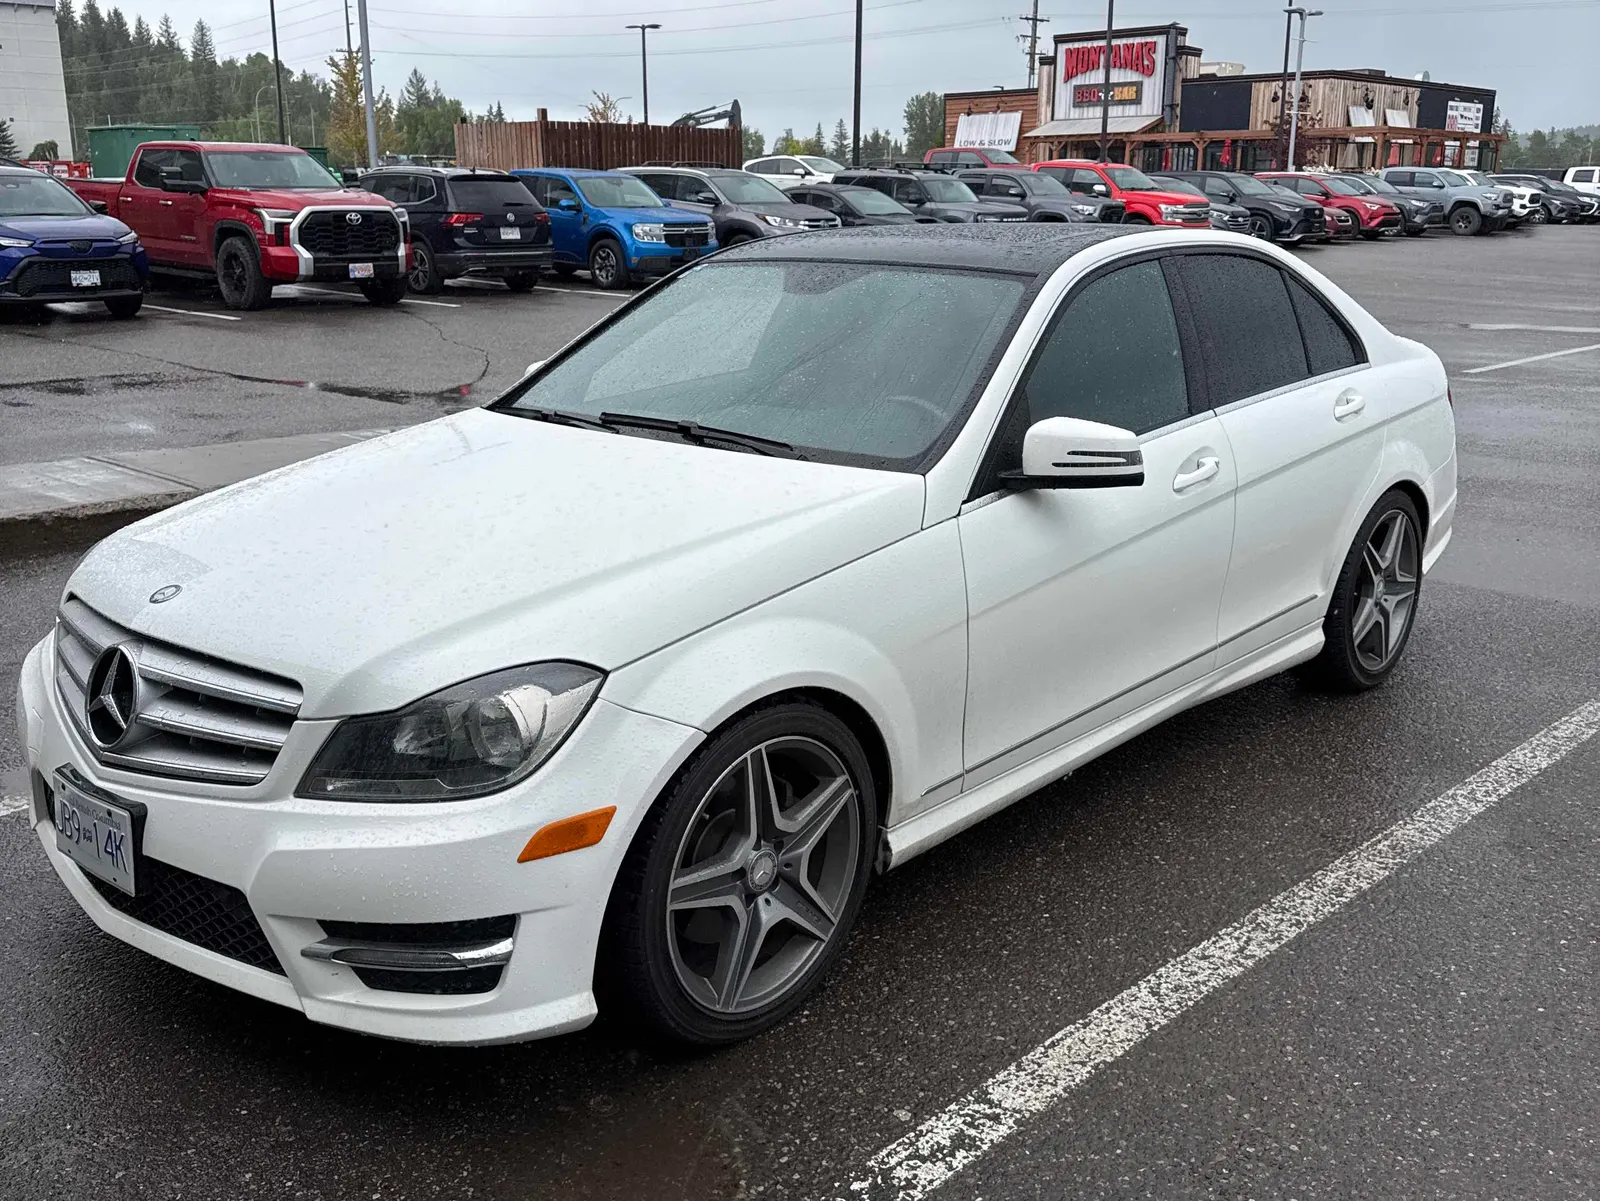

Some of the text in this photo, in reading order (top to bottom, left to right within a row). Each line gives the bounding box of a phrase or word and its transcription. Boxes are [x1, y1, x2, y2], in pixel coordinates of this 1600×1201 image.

[1076, 88, 1098, 103] BBQ
[56, 799, 128, 873] JB9 14K
